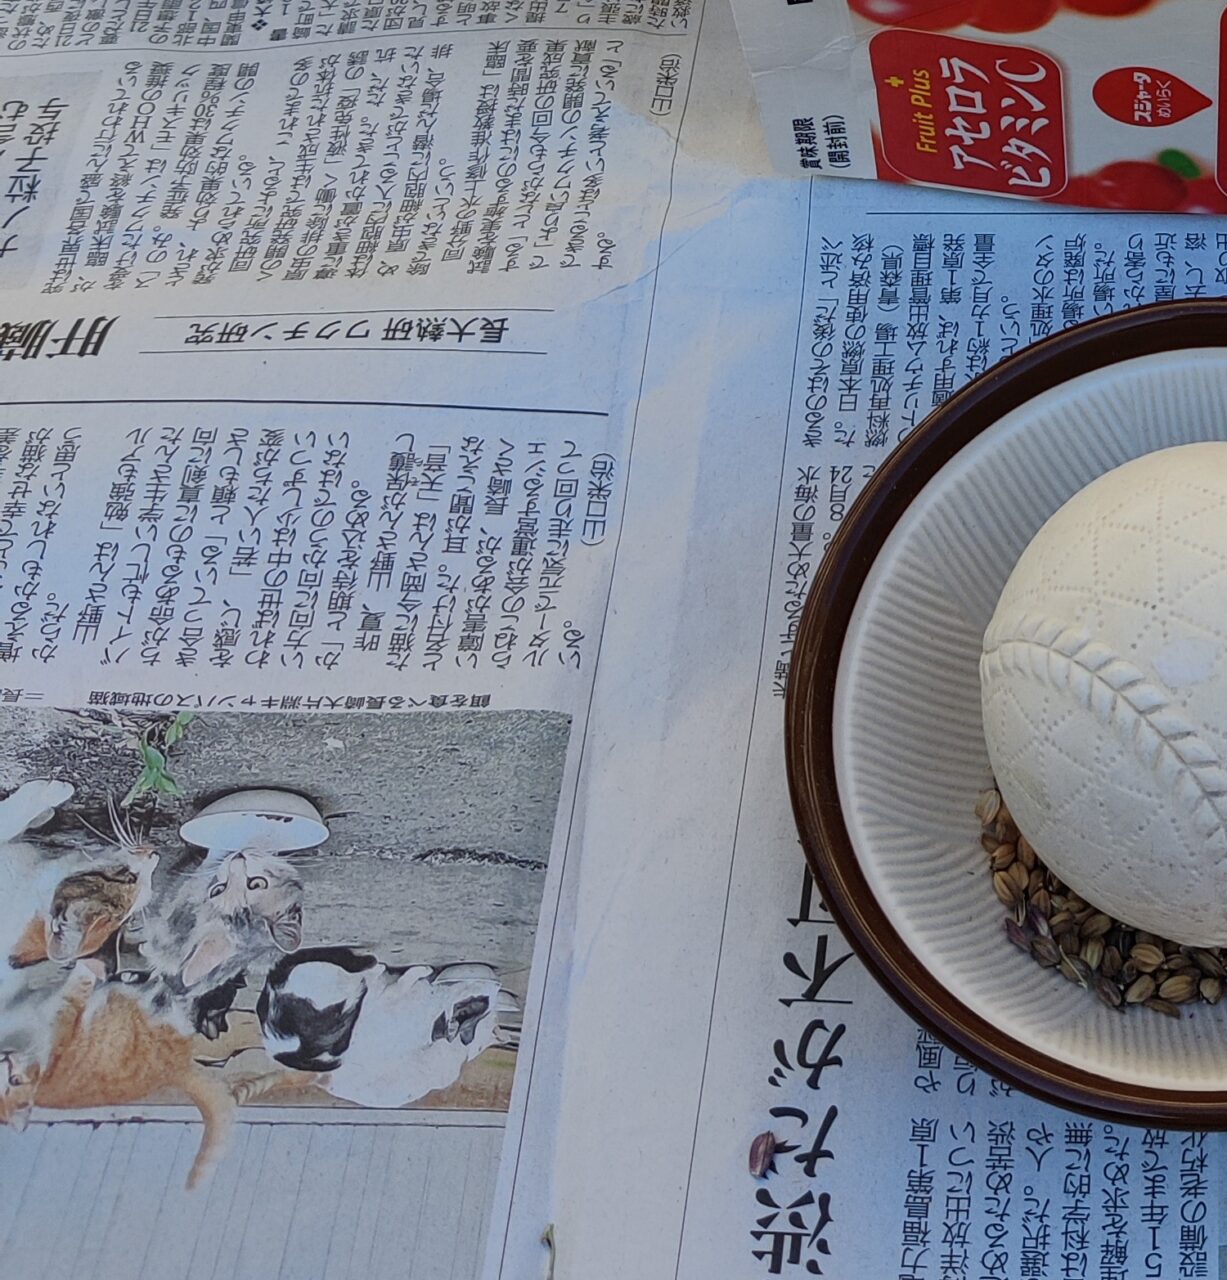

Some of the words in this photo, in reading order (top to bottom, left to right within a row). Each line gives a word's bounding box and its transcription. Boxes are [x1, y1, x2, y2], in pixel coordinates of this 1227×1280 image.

[910, 69, 932, 108] Plus
[1133, 72, 1152, 122] スジャータ
[1154, 79, 1172, 118] めいらく
[913, 113, 937, 153] Fruit
[938, 56, 998, 171] アセロラ
[995, 58, 1051, 187] ビタミンC
[792, 117, 823, 169] 賞味期限
[185, 319, 371, 345] ワクチン研究
[384, 317, 510, 343] 長大熱研
[32, 592, 70, 663] からだ。
[558, 620, 585, 669] いる。
[1018, 1122, 1054, 1279] 選択だ。人や
